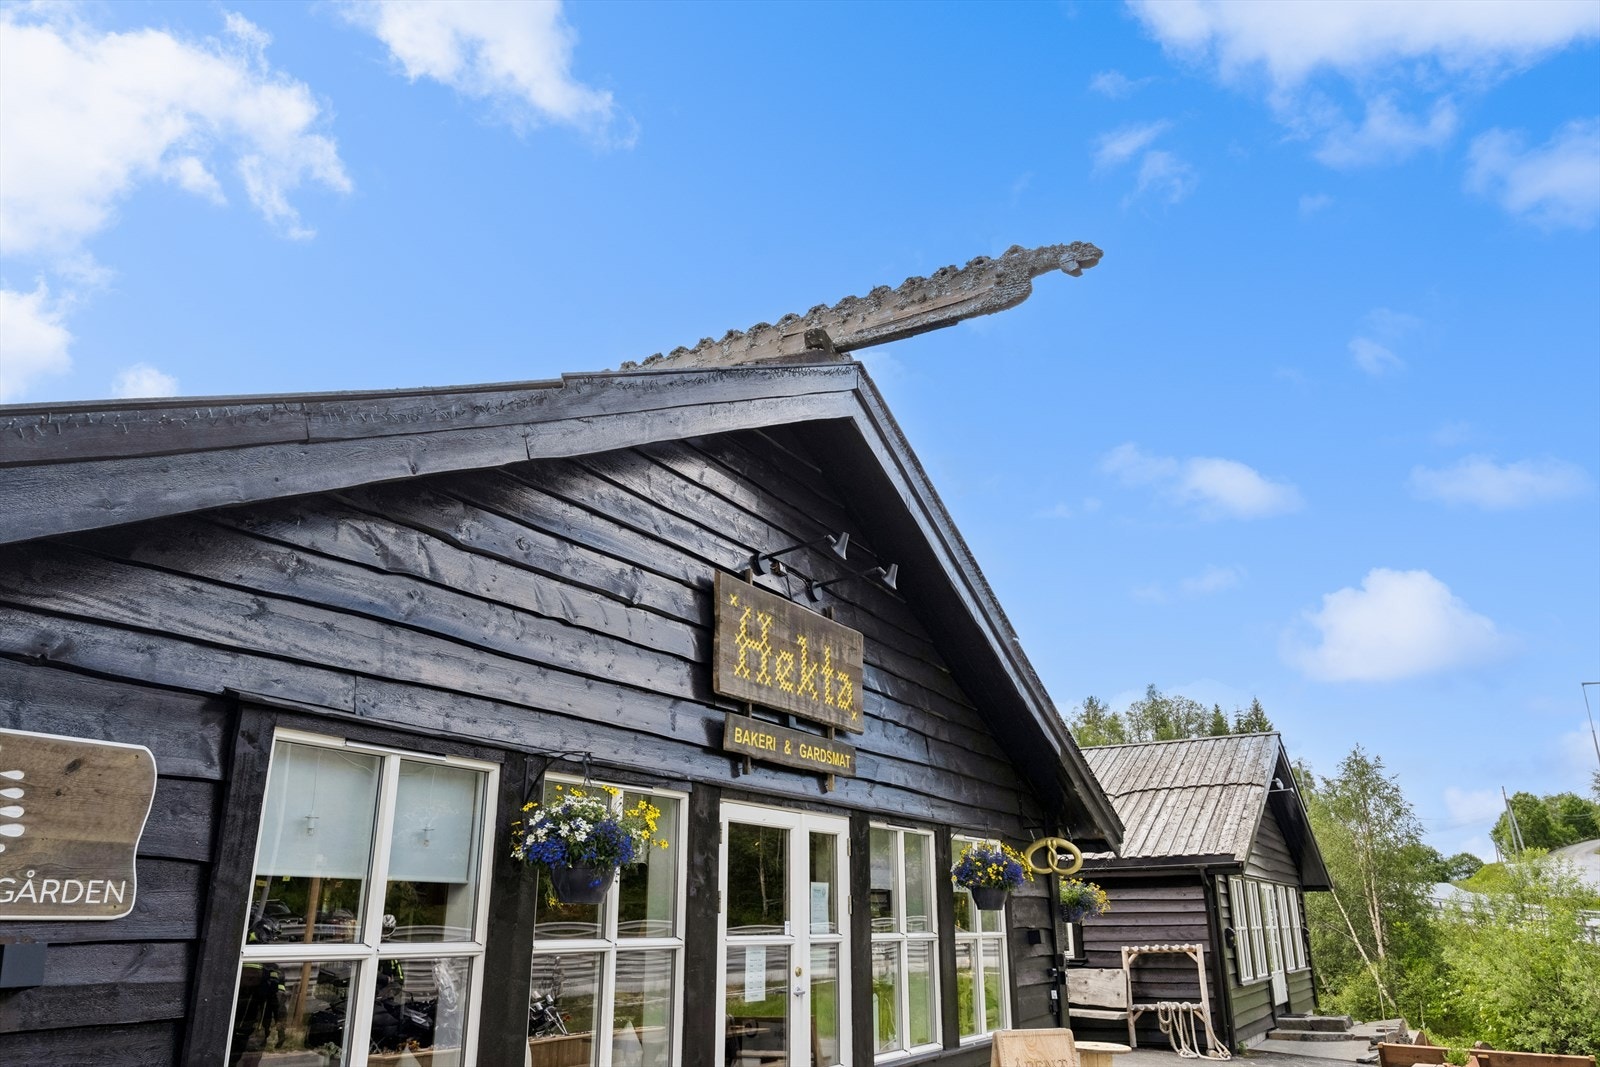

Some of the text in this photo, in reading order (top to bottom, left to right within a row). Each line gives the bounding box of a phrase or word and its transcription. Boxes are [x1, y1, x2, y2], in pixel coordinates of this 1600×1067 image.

[734, 727, 851, 769] BAKERI & GARDSMAT
